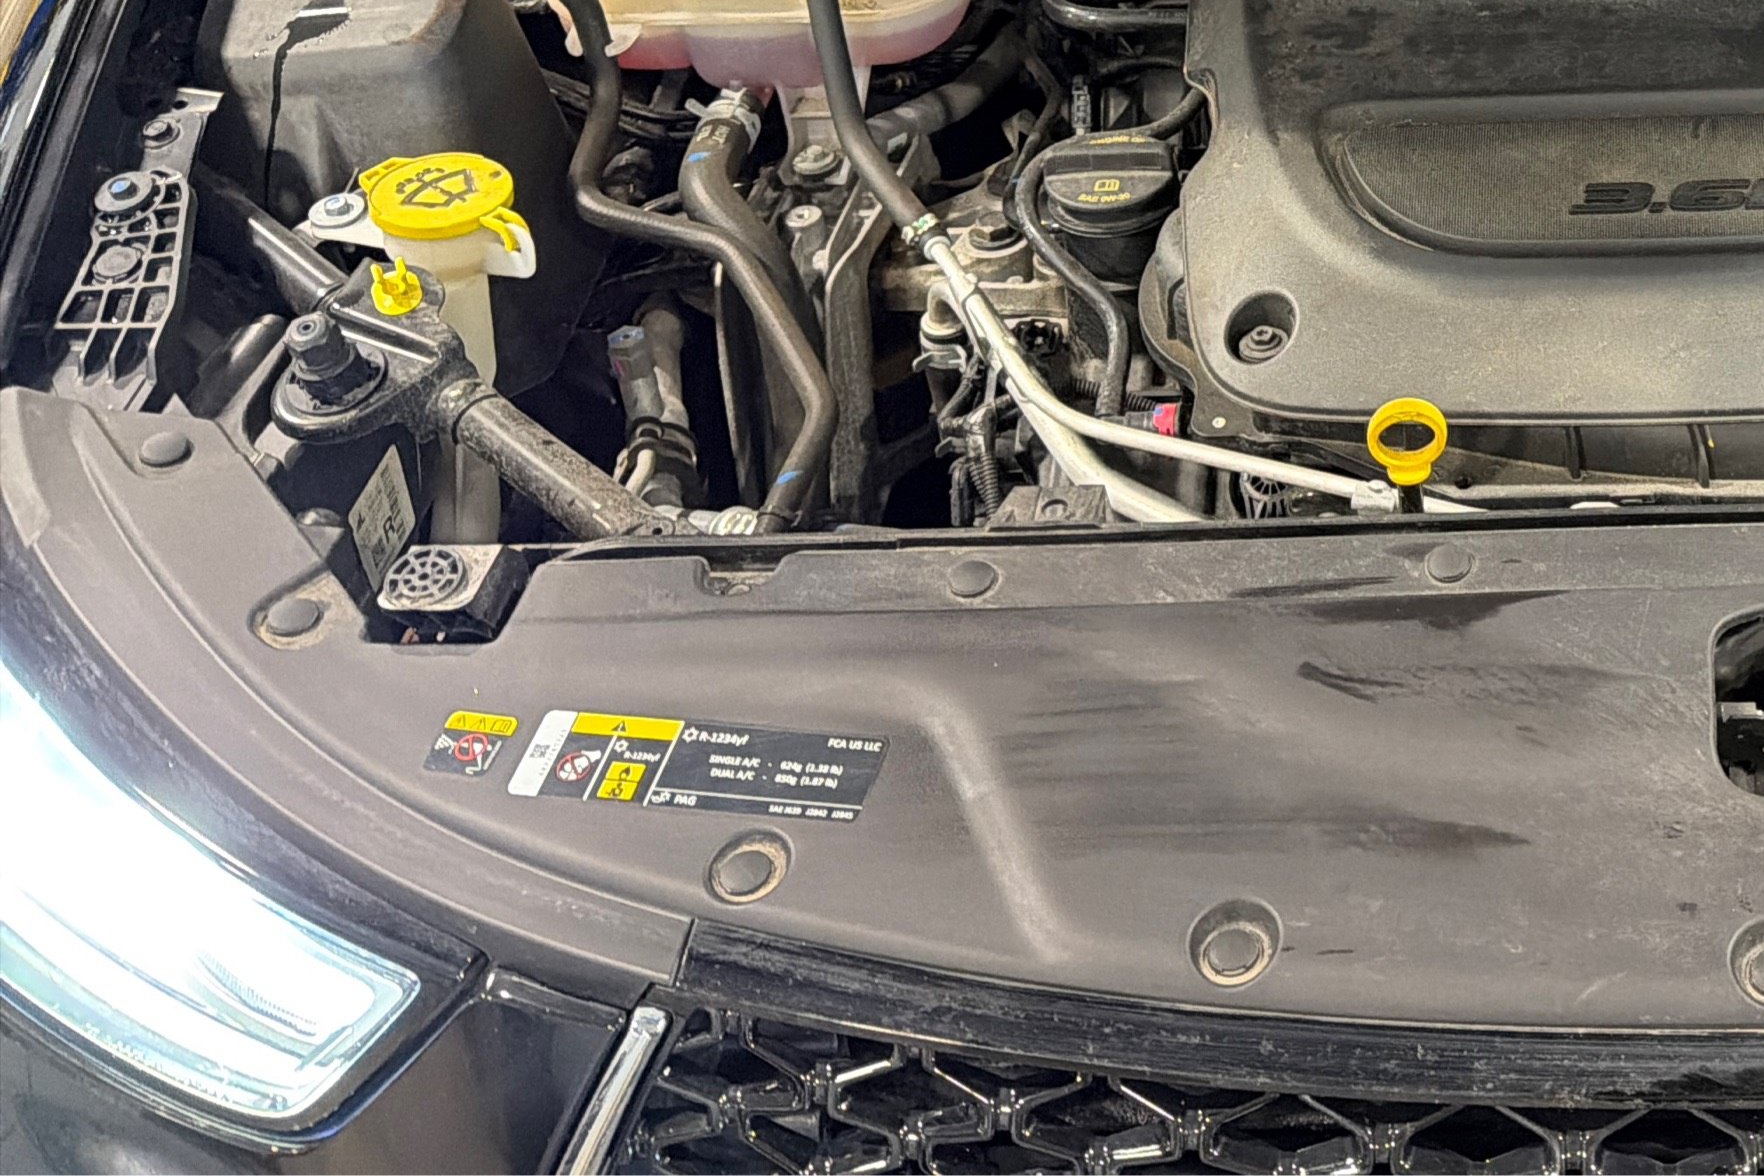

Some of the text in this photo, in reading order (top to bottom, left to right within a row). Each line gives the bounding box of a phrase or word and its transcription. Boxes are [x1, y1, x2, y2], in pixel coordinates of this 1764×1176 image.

[699, 731, 749, 745] R-1234yf
[827, 737, 883, 752] FCA US LLC
[708, 754, 742, 767] SINGLE
[741, 757, 761, 768] A/C
[710, 767, 735, 779] DUAL
[735, 770, 756, 781] A/C
[673, 794, 697, 806] PAG
